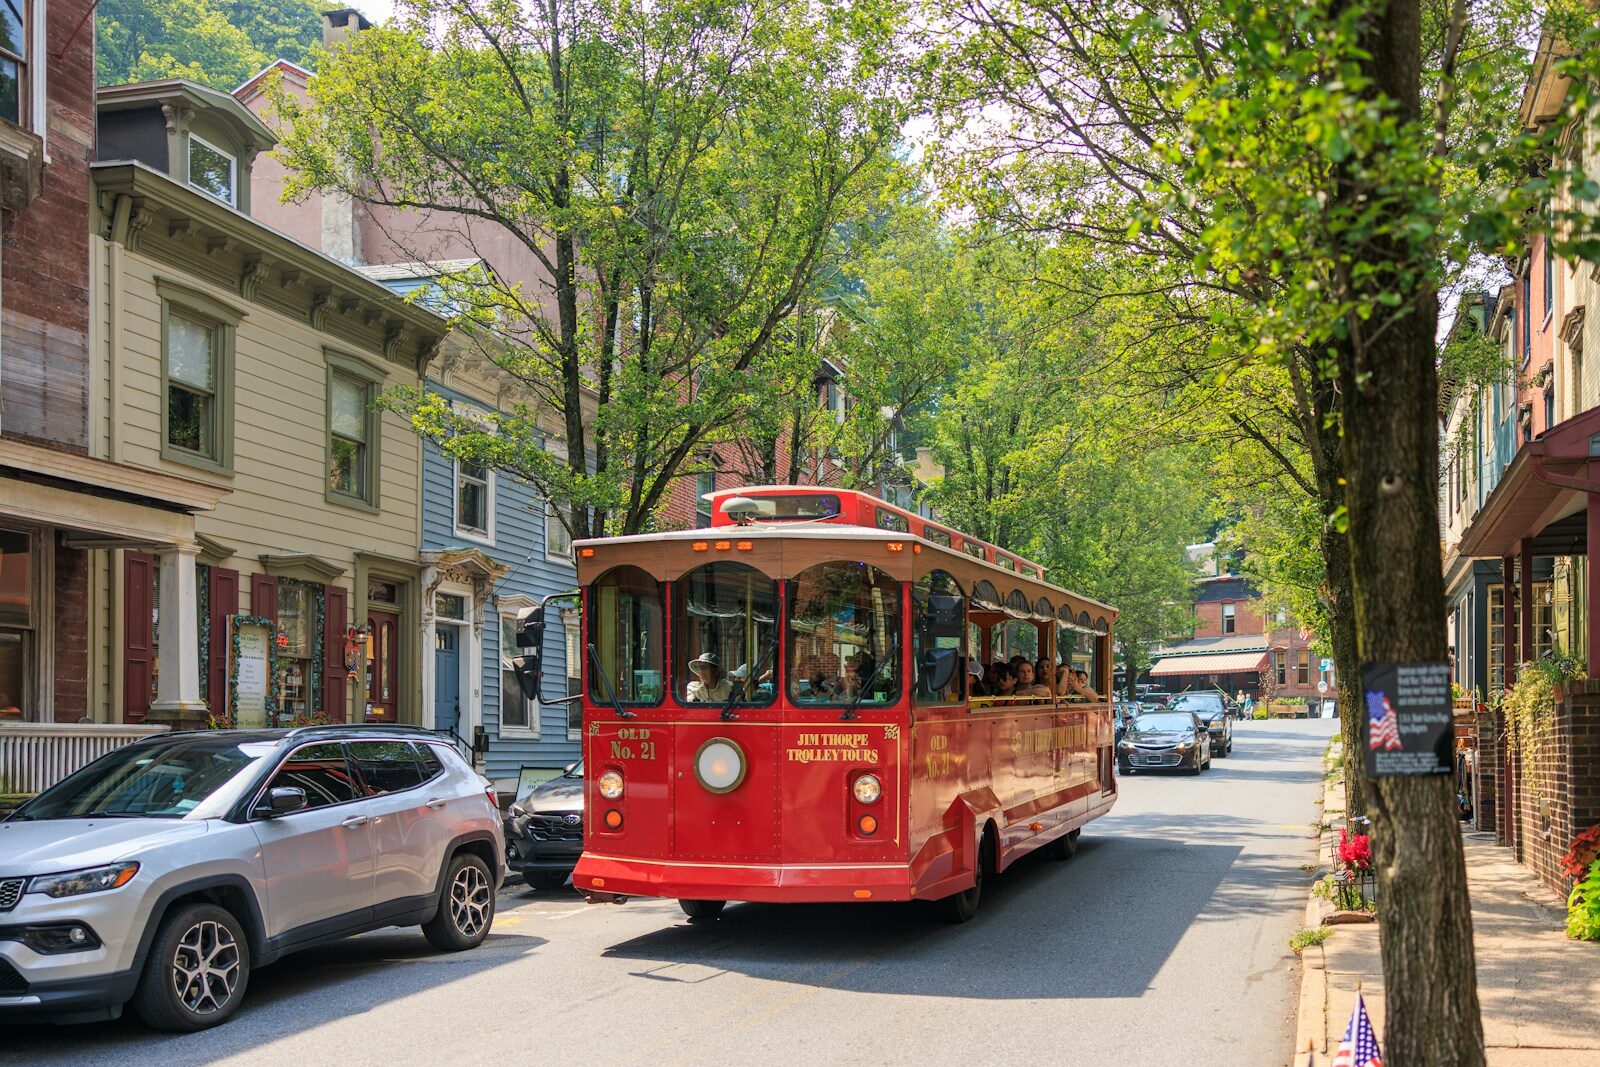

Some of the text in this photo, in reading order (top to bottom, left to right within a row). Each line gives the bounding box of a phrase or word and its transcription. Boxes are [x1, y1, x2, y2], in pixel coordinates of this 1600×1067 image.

[617, 728, 651, 740] OLD
[797, 733, 869, 749] JIM THORPE
[610, 740, 656, 760] No. 21
[930, 735, 947, 751] OLD
[786, 748, 879, 764] TROLLEY TOURS
